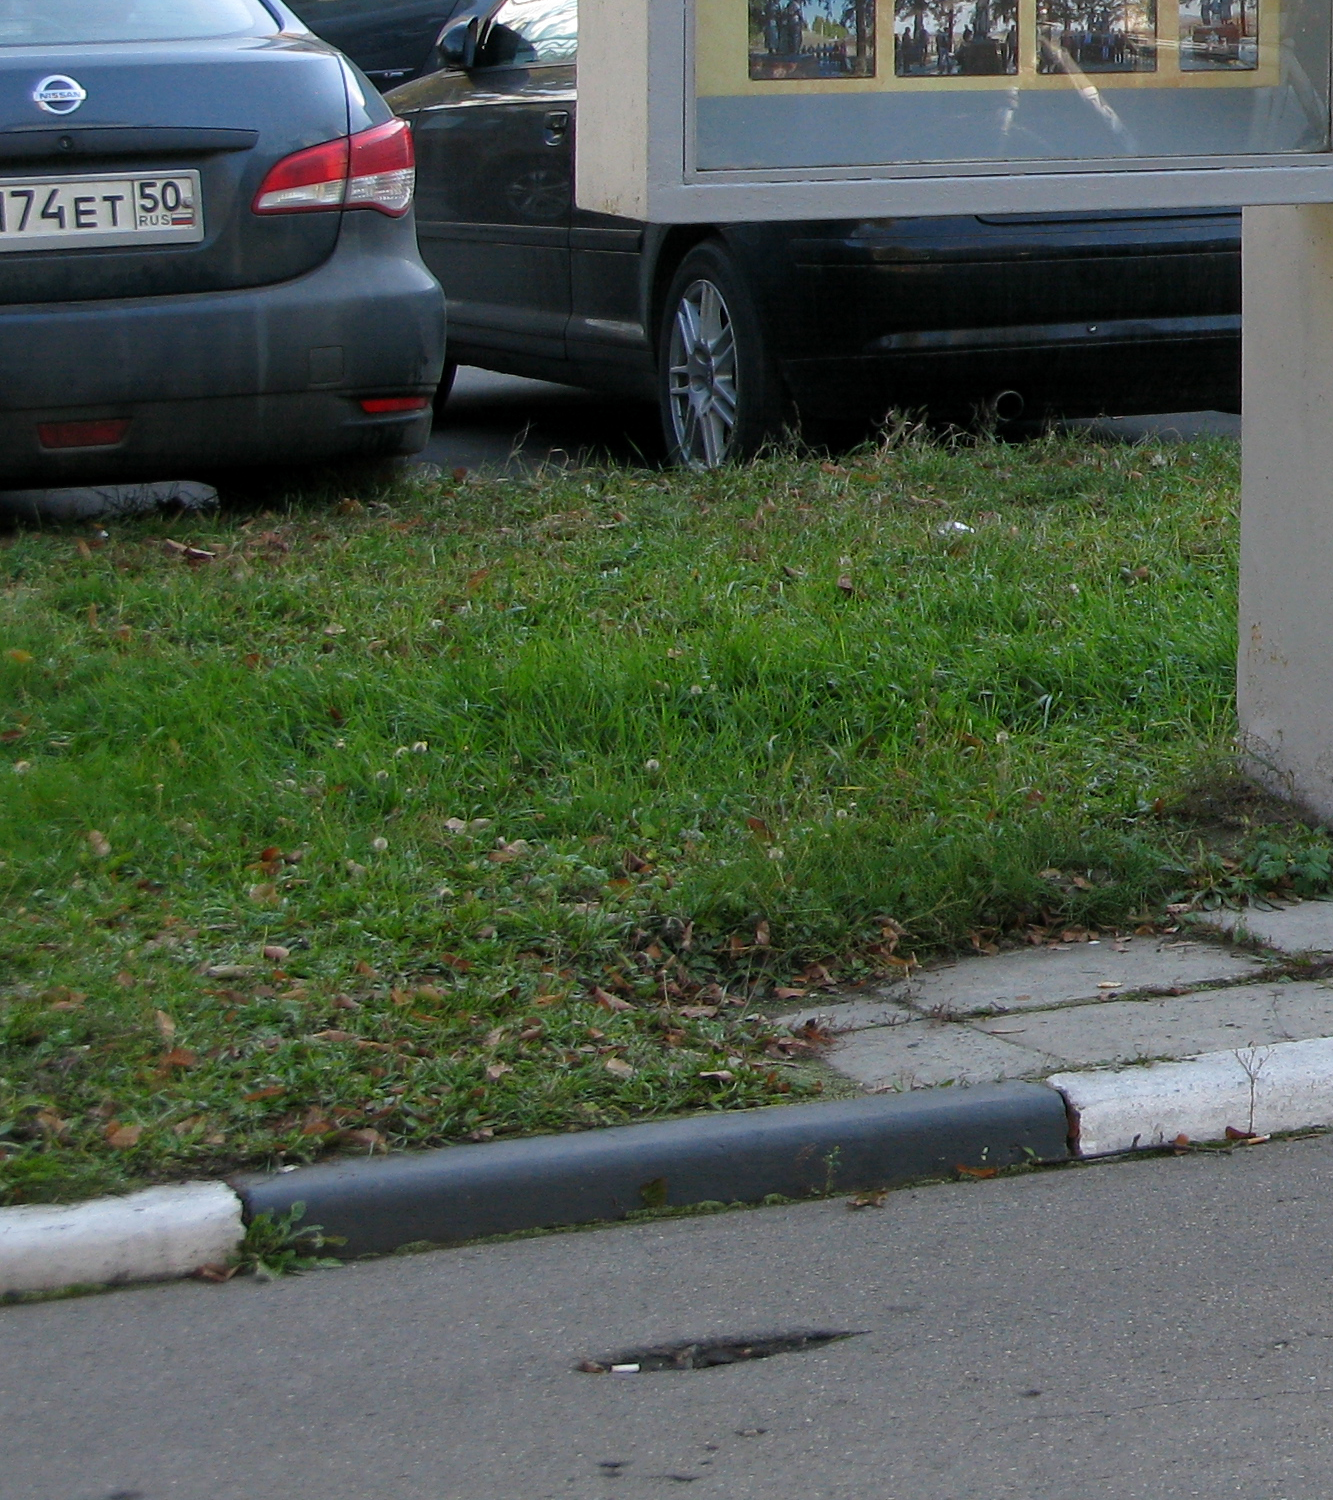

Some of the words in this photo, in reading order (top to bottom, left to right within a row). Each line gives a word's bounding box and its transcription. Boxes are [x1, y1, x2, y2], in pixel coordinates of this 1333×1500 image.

[39, 91, 81, 100] NISSAN
[139, 180, 182, 213] 50
[139, 213, 170, 227] RUS
